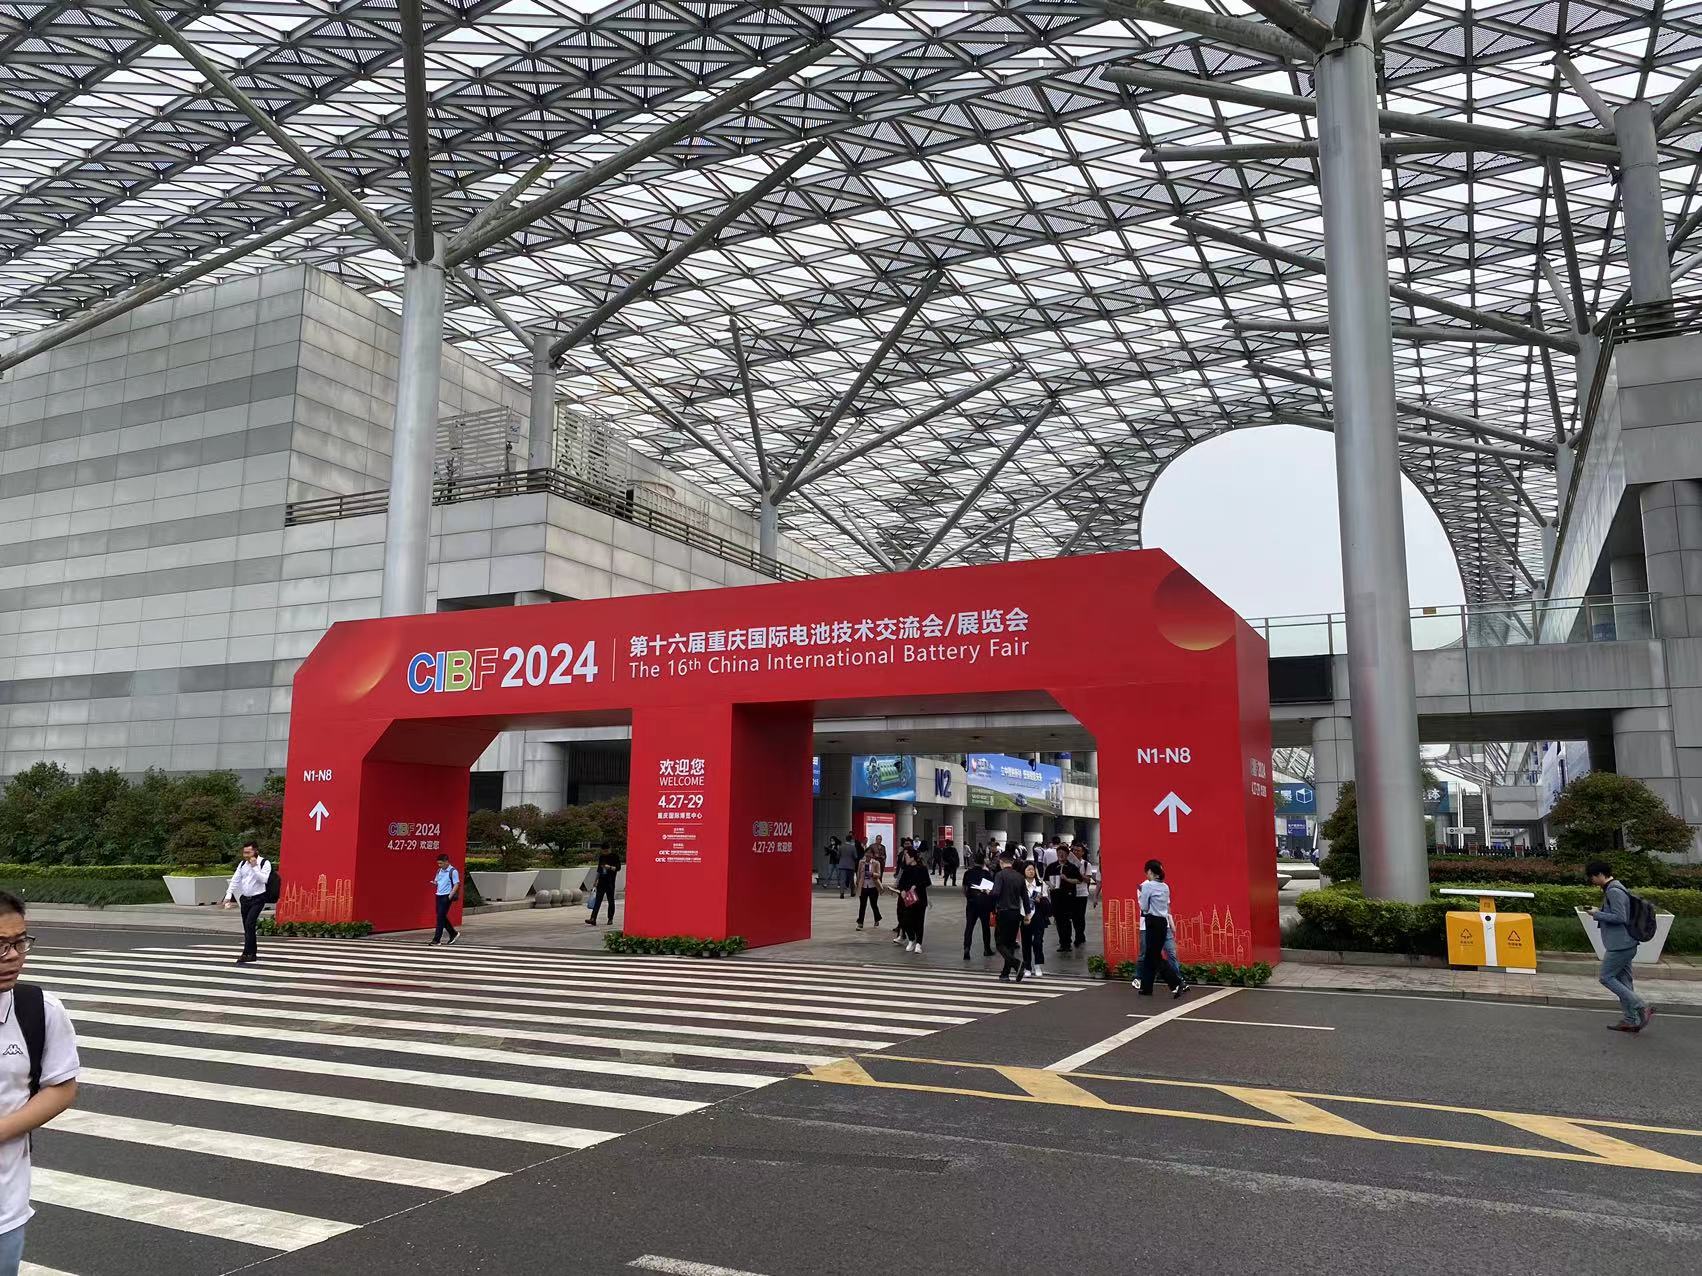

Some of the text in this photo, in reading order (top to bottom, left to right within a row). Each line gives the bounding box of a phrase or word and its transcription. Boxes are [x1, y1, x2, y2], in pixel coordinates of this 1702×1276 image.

[629, 606, 1029, 658] 第十六届重庆国际电池技术交流会/展览会
[629, 638, 1029, 679] The 16th China International Battery Fair
[407, 640, 598, 695] CIBF 2024
[1137, 747, 1191, 764] N1-N8
[659, 758, 705, 776] 欢迎您
[303, 769, 332, 782] N1-N8
[659, 776, 704, 787] WELCOME
[935, 768, 952, 798] N2
[658, 794, 703, 809] 4.27-29
[388, 822, 440, 836] CIBF 2024
[773, 822, 792, 836] 2024
[387, 840, 440, 850] 4.27-29 欢迎您
